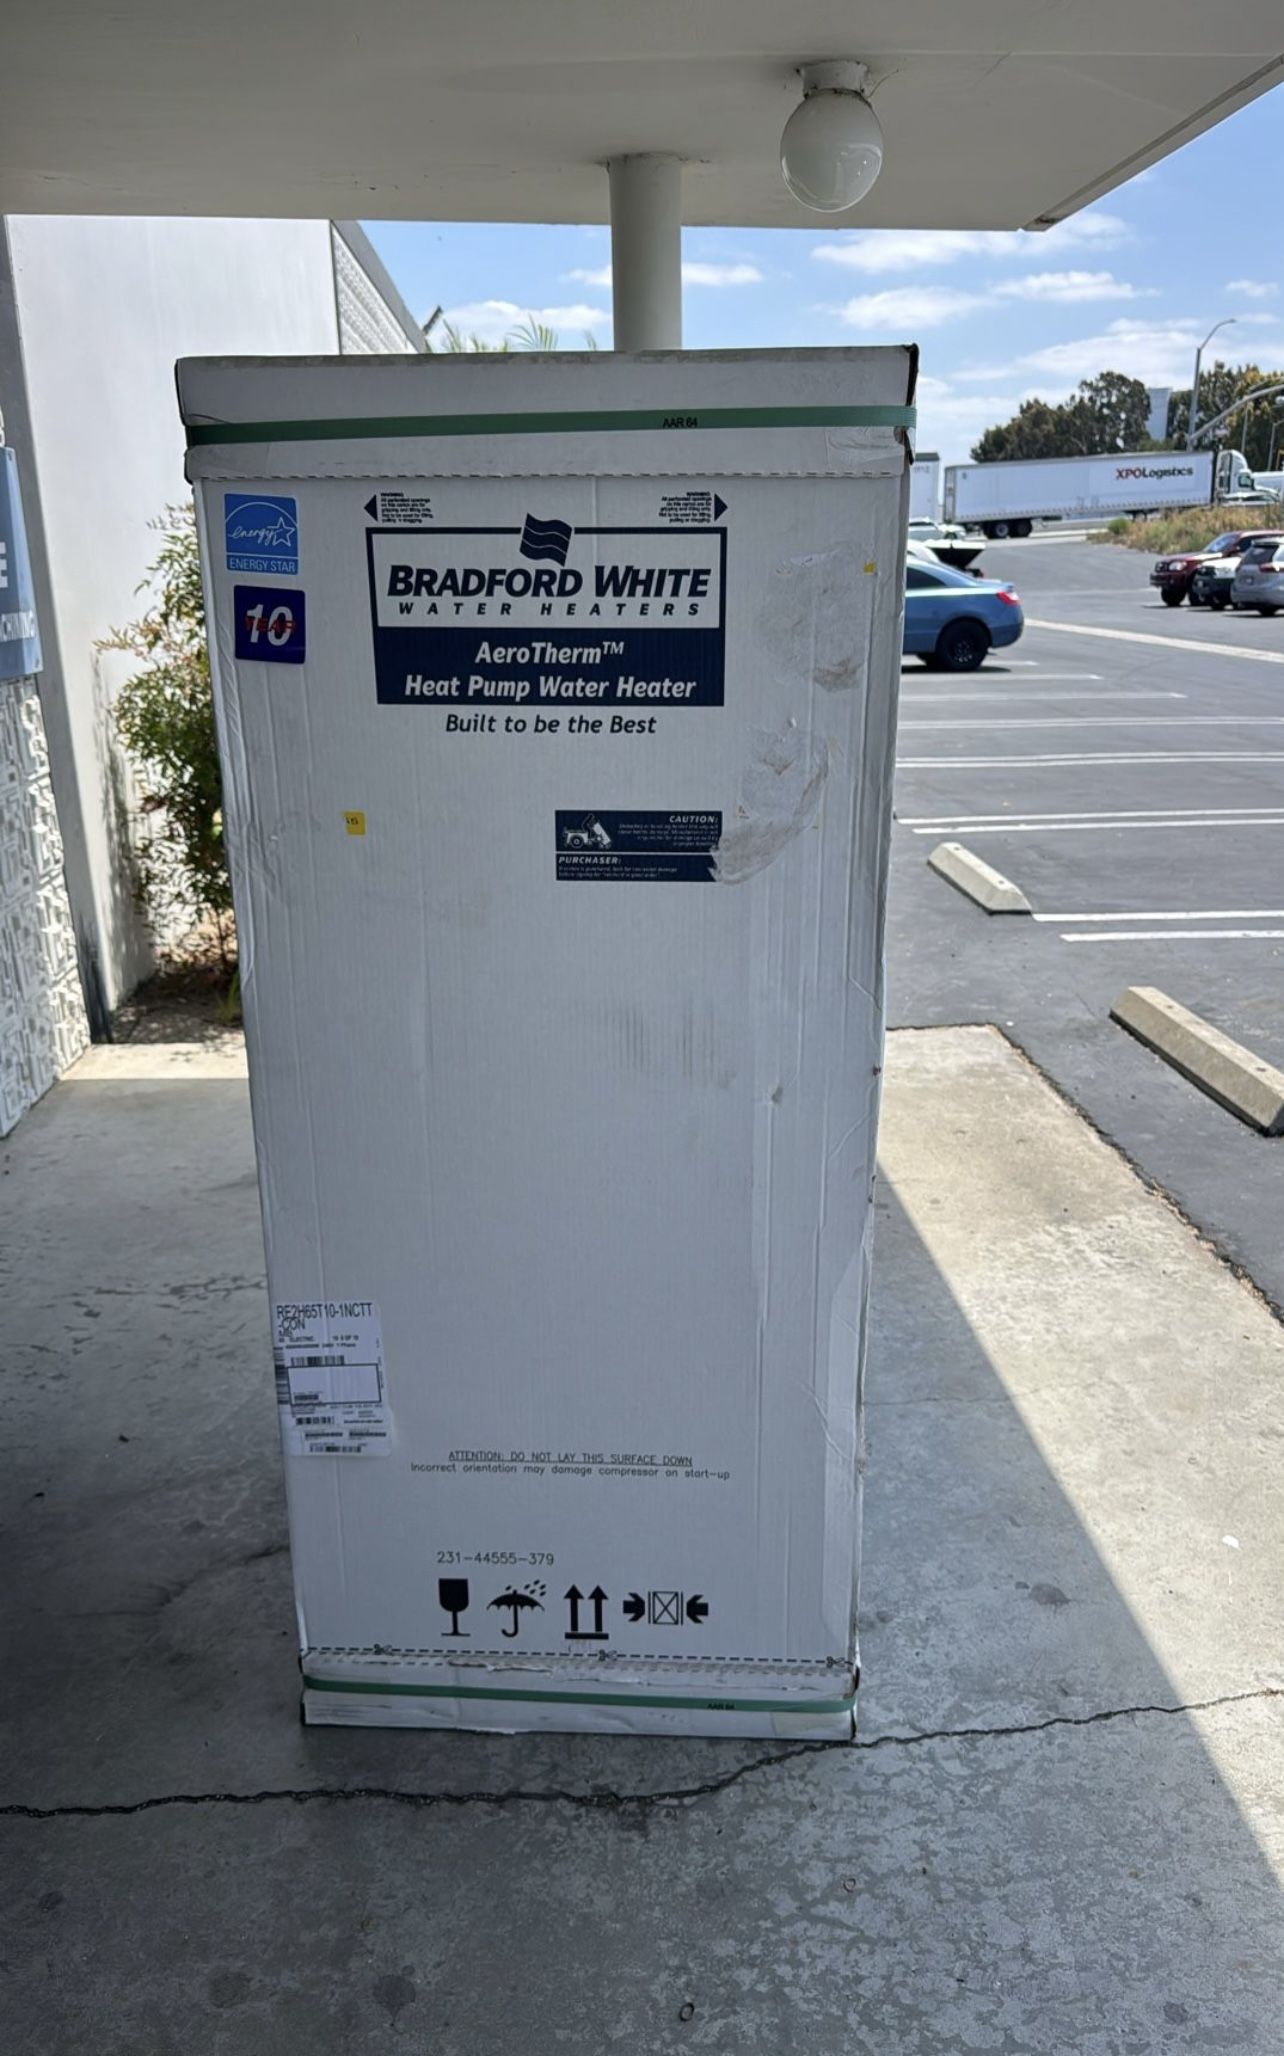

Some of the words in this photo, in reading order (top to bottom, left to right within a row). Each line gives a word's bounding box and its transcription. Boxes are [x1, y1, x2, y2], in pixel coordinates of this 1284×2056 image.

[663, 417, 684, 429] AAR
[230, 557, 269, 571] ENERGY
[270, 560, 296, 573] STAR
[387, 565, 584, 598] BRADFORD
[595, 565, 712, 598] WHITE
[399, 602, 511, 616] WATER
[540, 602, 699, 616] HEATERS
[246, 604, 293, 646] 10
[405, 675, 460, 697] Heat
[467, 675, 530, 702] Pump
[539, 675, 609, 698] Water
[616, 676, 697, 698] Heater
[445, 714, 497, 733] Built
[504, 716, 527, 733] to
[534, 715, 560, 733] be
[567, 715, 603, 733] the
[609, 715, 657, 734] Best
[510, 1452, 525, 1462] DO
[531, 1452, 551, 1462] NOT
[558, 1453, 576, 1462] LAY
[582, 1453, 604, 1464] THIS
[611, 1454, 657, 1465] SURFACE
[663, 1455, 692, 1466] DOWN
[410, 1462, 456, 1472] Incorrect
[462, 1463, 518, 1473] orientation
[523, 1466, 545, 1476] may
[551, 1465, 592, 1477] damage
[599, 1467, 659, 1477] compressor
[665, 1469, 678, 1477] on
[684, 1469, 731, 1480] start-up
[437, 1551, 555, 1565] 231-44555-379
